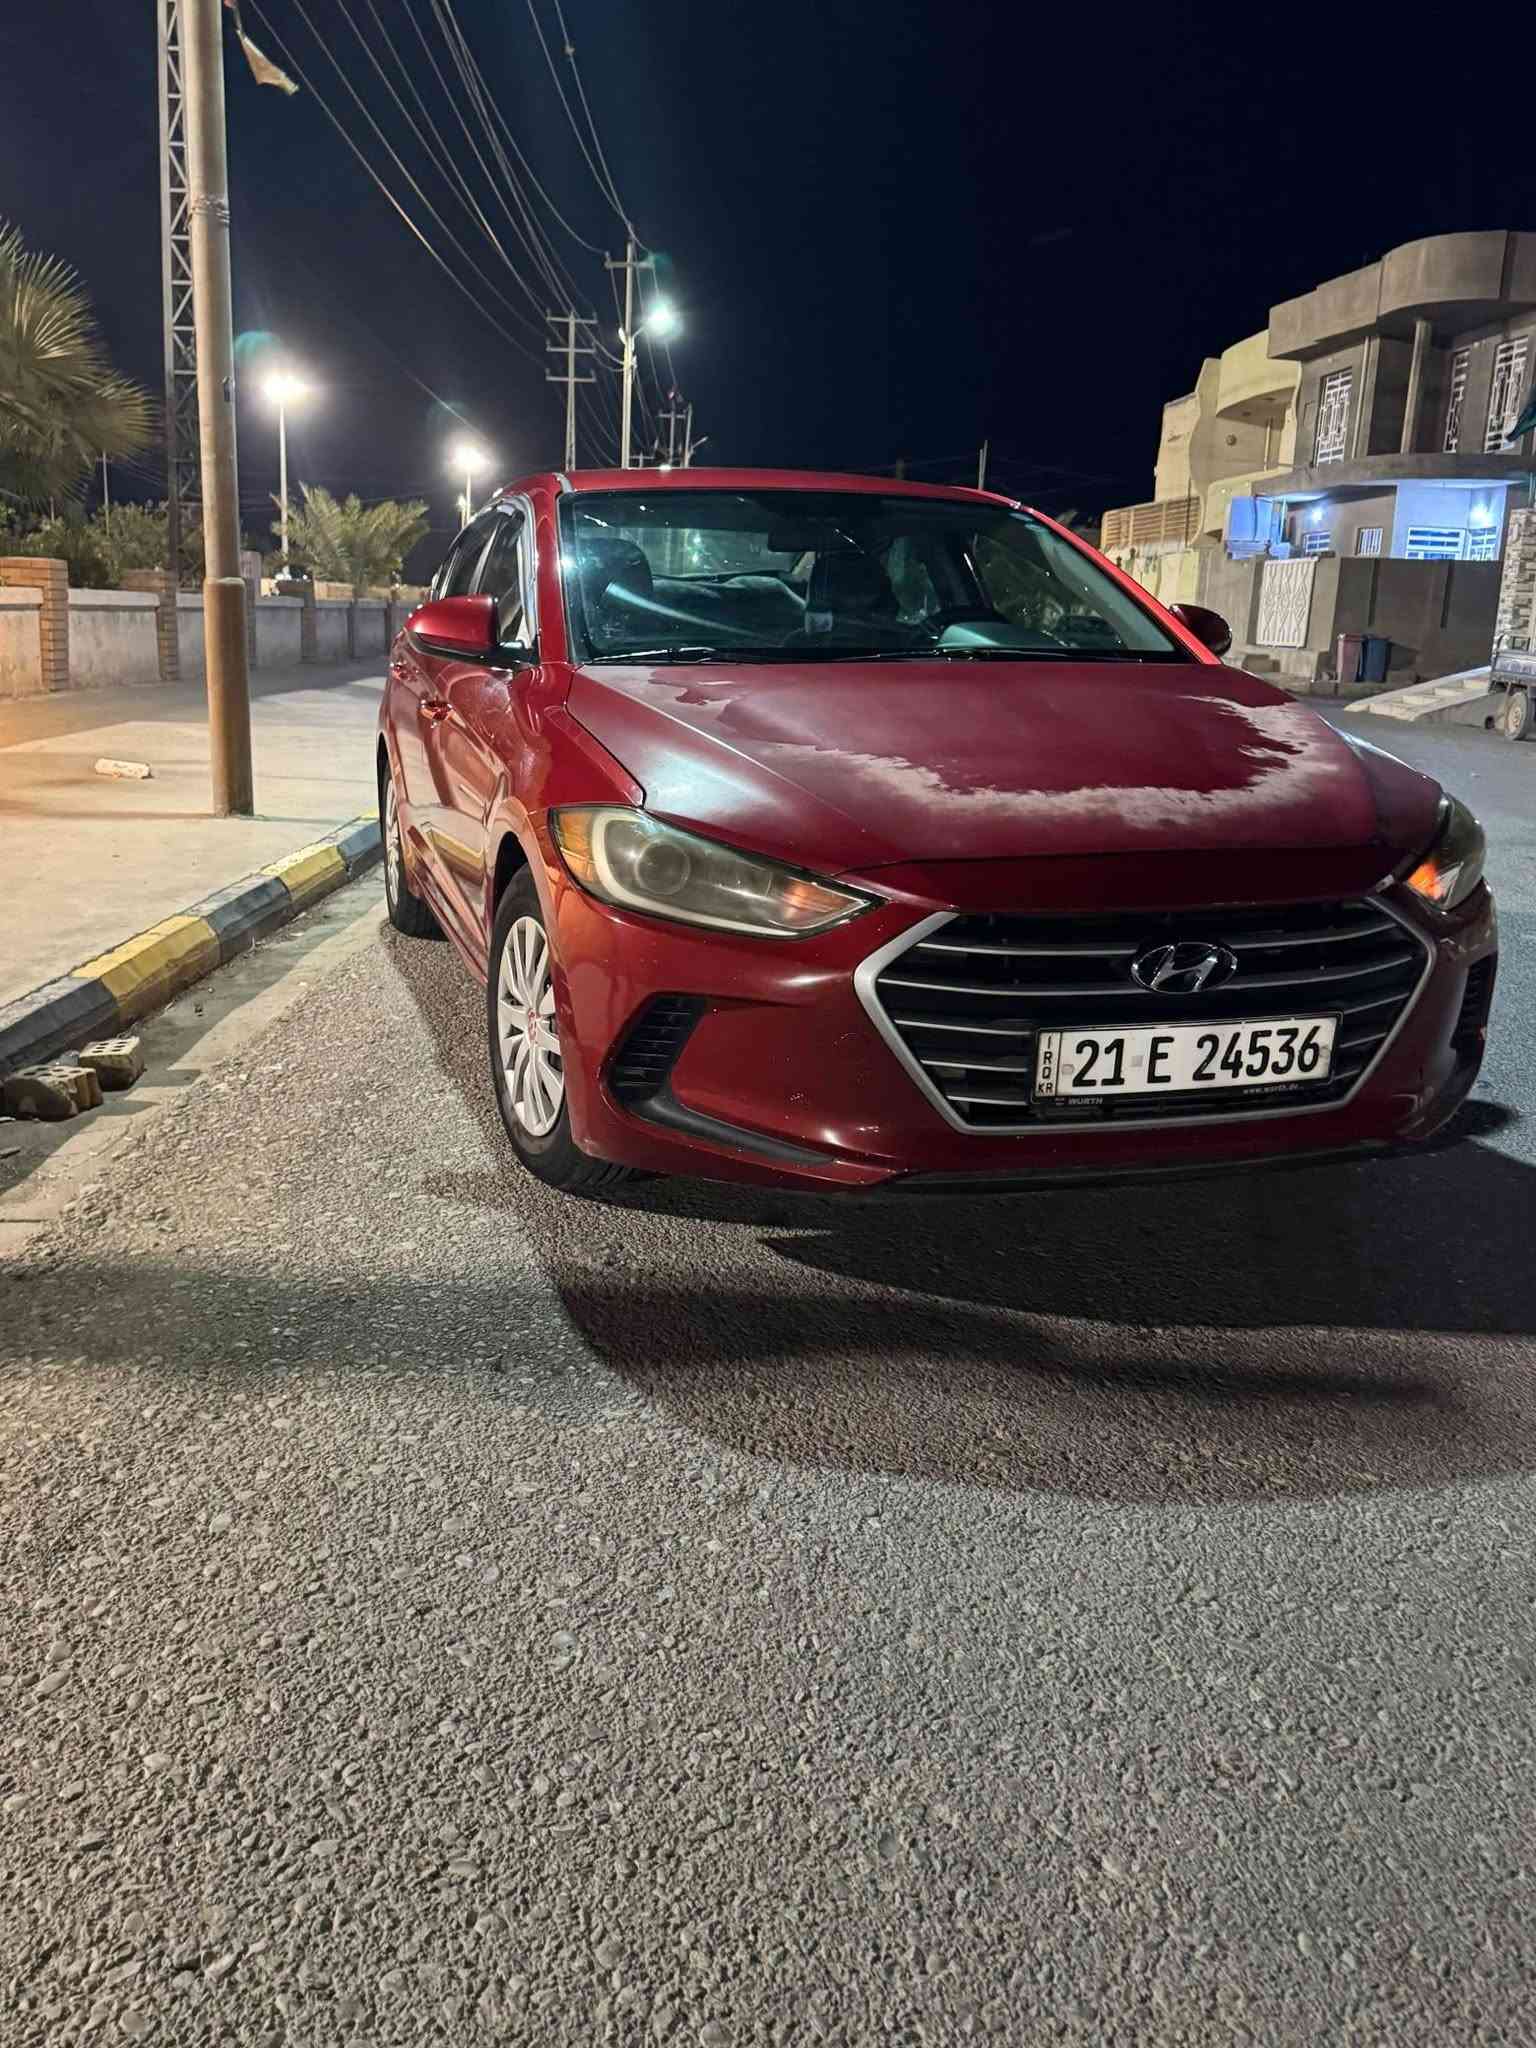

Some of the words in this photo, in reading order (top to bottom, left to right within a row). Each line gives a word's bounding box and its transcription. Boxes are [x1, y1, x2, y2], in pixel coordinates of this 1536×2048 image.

[1072, 1038, 1125, 1087] 21
[1147, 1036, 1173, 1084] E
[1192, 1025, 1321, 1081] 24536
[1038, 1082, 1053, 1094] KR
